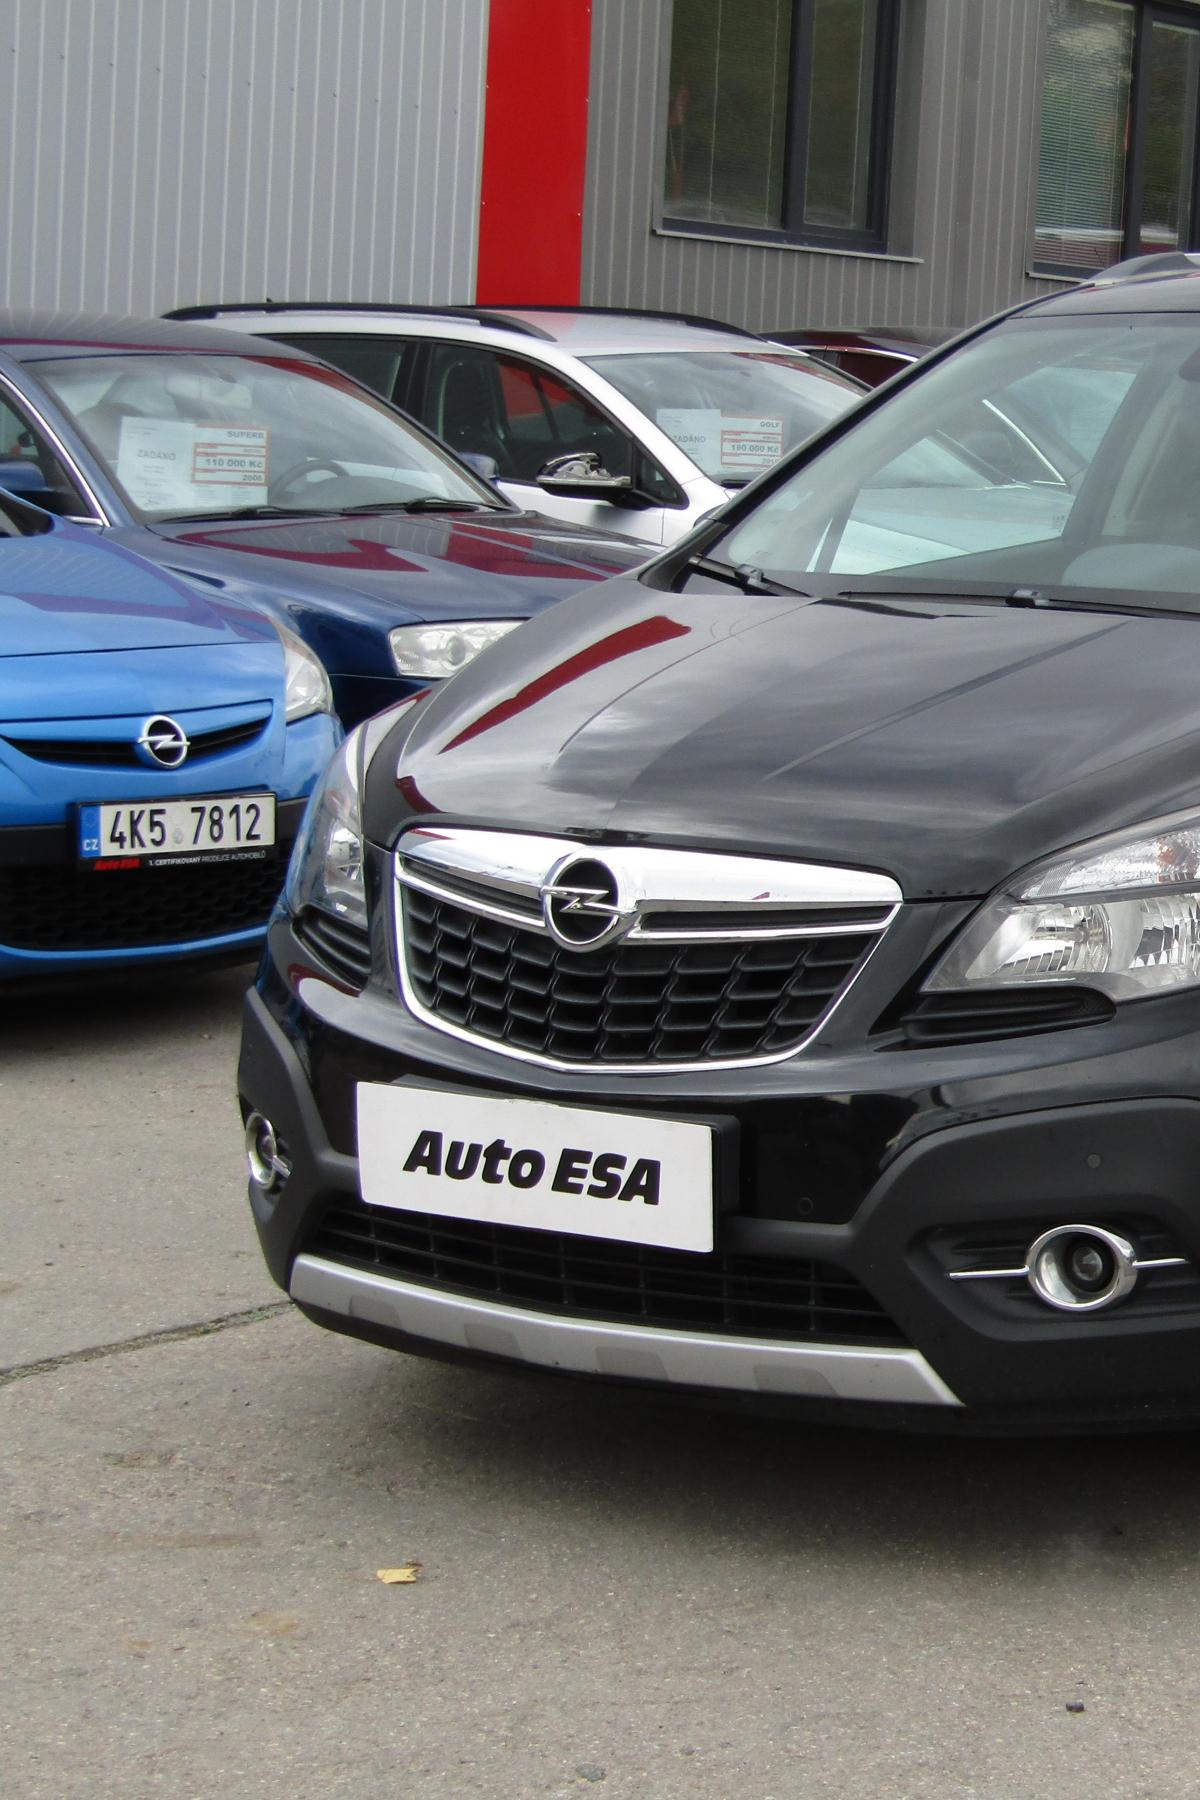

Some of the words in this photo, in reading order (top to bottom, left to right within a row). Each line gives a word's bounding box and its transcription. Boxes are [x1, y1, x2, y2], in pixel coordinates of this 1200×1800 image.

[83, 839, 99, 851] CZ
[110, 808, 167, 850] 4K5
[191, 803, 262, 845] 7812
[402, 1129, 547, 1189] Auto
[551, 1147, 661, 1206] ESA
